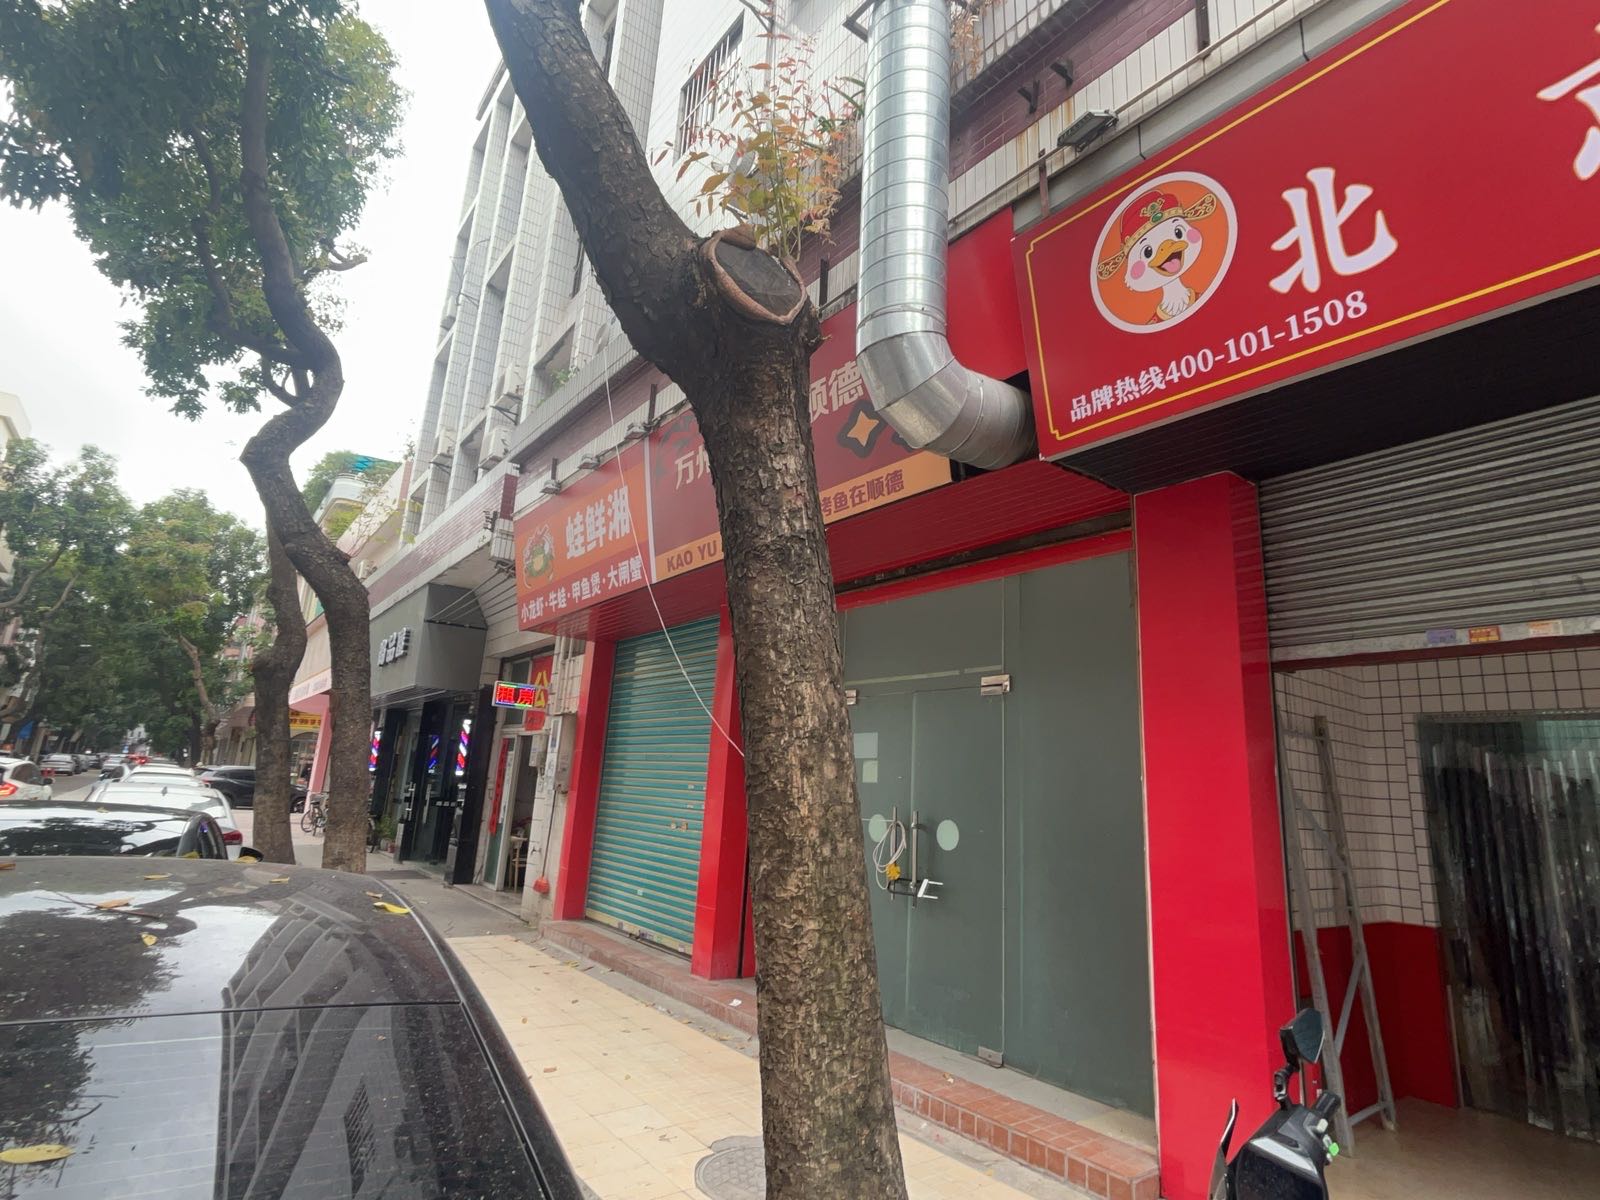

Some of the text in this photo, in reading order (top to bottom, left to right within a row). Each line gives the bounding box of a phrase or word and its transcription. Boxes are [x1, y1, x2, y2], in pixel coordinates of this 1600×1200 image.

[1269, 166, 1398, 294] 北
[1070, 290, 1368, 423] 品牌热线400-101-1508
[565, 485, 631, 560] 蛙鲜湘
[666, 539, 718, 573] KAO YU
